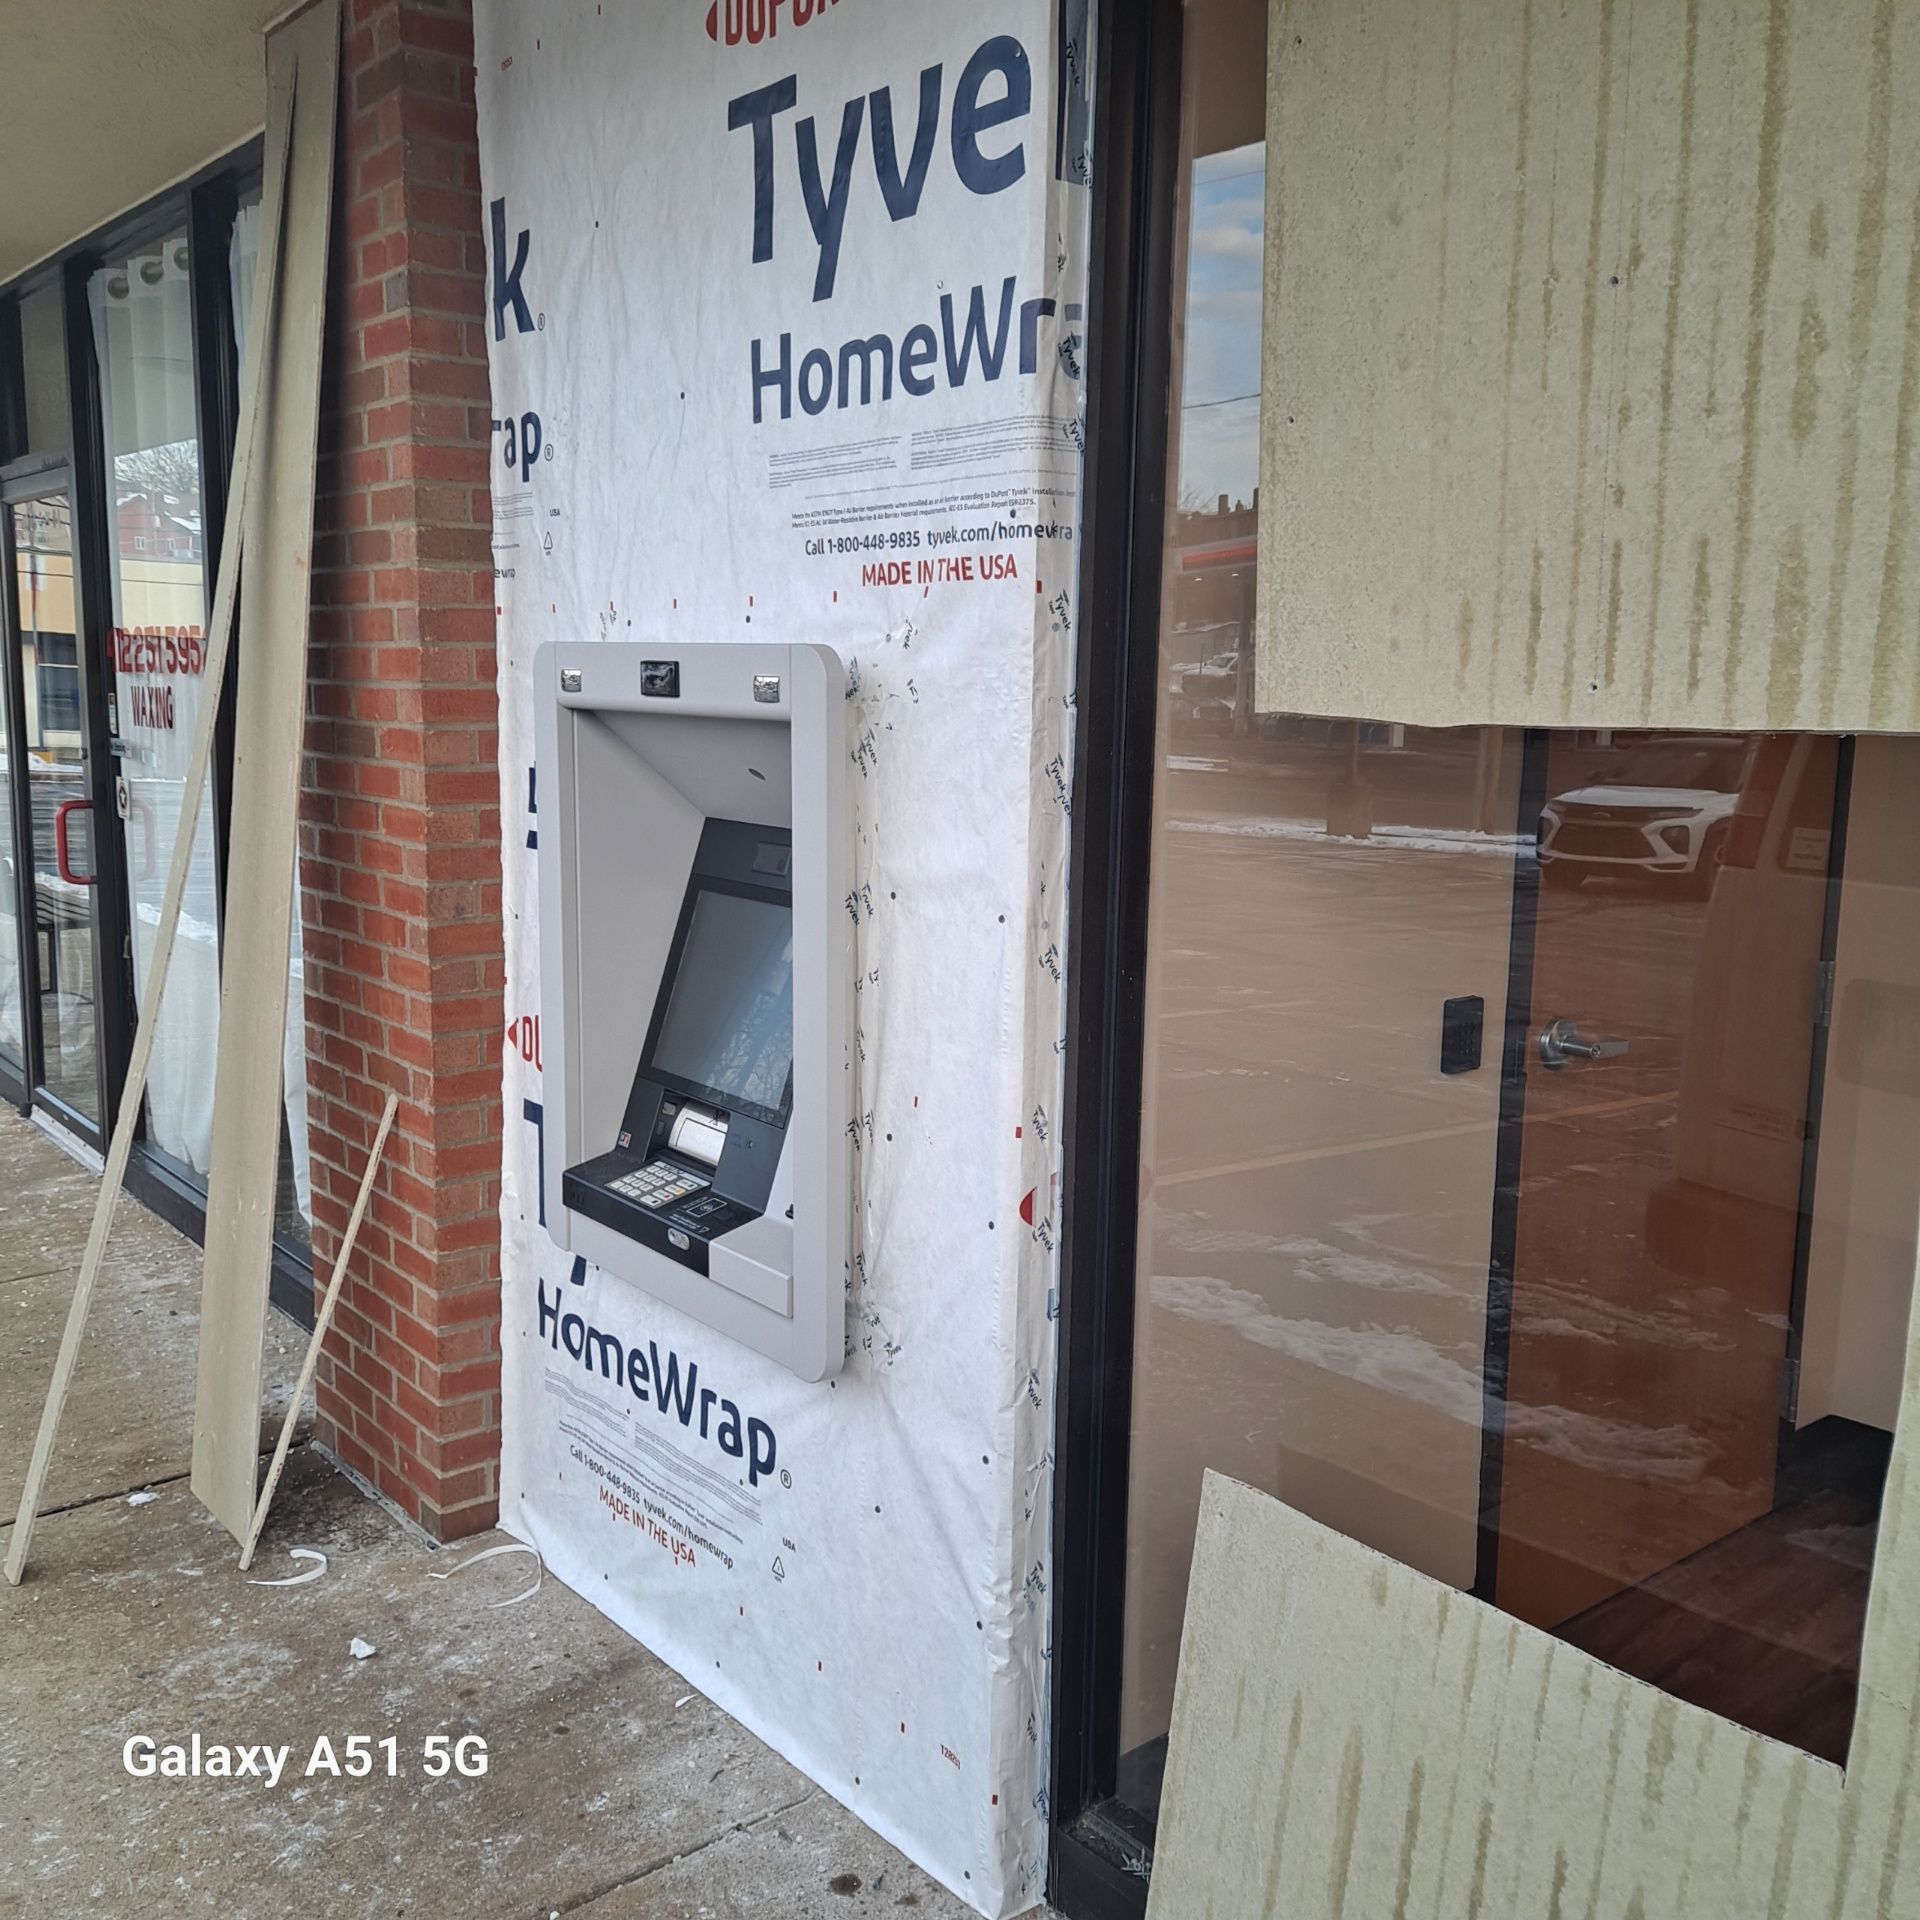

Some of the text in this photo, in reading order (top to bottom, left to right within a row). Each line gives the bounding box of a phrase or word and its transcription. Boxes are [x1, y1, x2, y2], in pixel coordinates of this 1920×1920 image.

[728, 0, 1093, 303] Tyve
[805, 537, 825, 556] Call
[827, 530, 920, 554] 1-800-448-9835
[862, 553, 1018, 587] MADE IN THE USA
[131, 685, 173, 730] WAXING
[570, 1444, 583, 1463] Call
[584, 1455, 640, 1504] 1-800-448-9835
[643, 1498, 733, 1570] tyvek.com/homewrap
[600, 1485, 696, 1568] MADE IN THE USA
